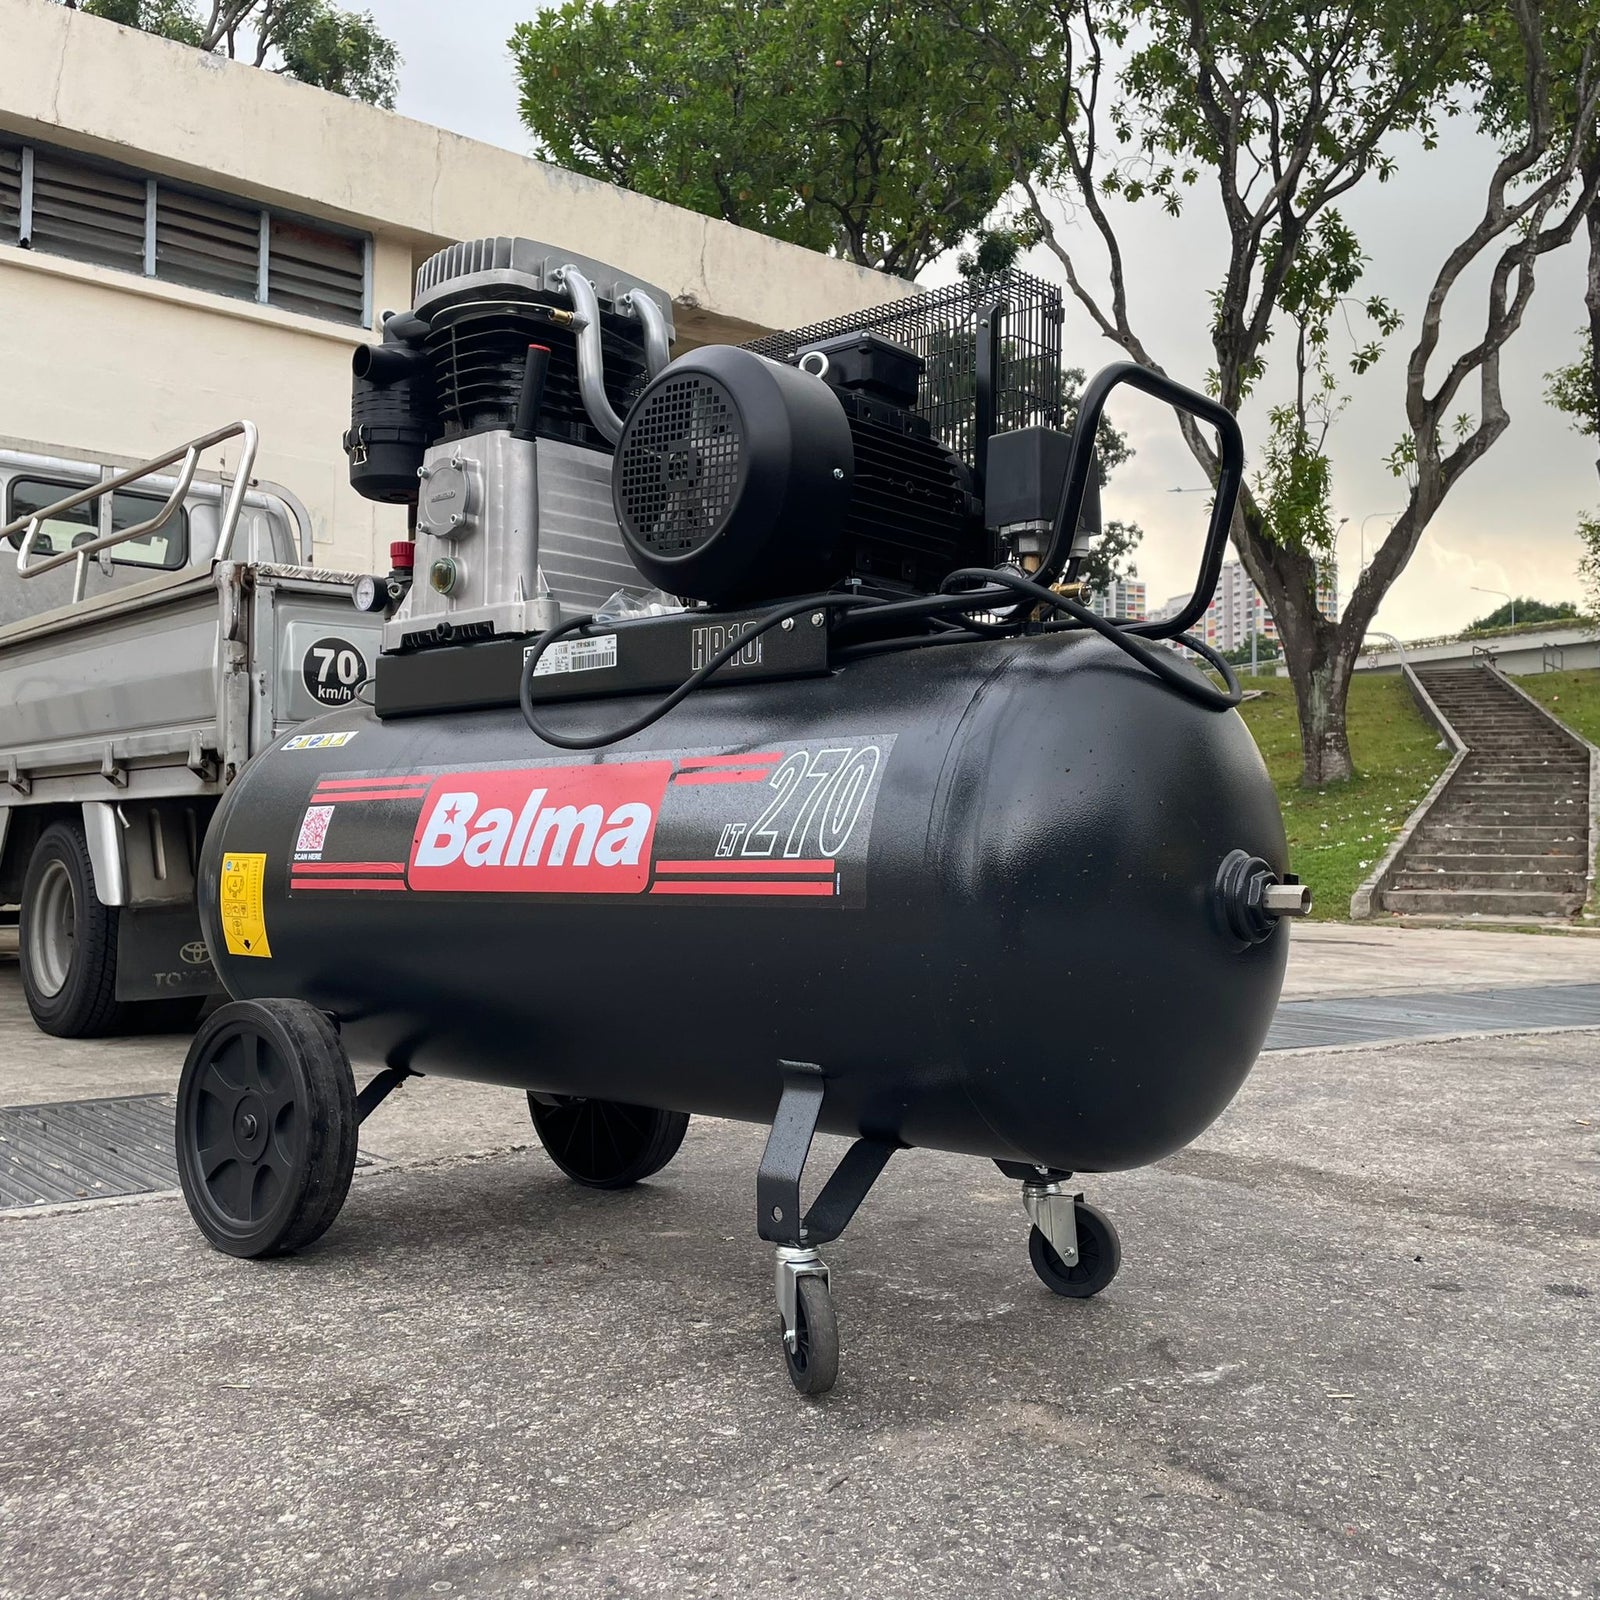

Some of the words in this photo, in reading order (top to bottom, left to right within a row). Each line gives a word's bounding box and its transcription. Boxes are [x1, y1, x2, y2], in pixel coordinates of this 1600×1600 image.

[313, 647, 359, 685] 70
[317, 684, 351, 700] km/h
[414, 788, 652, 868] Balma
[715, 823, 747, 857] LT
[741, 746, 880, 858] 270
